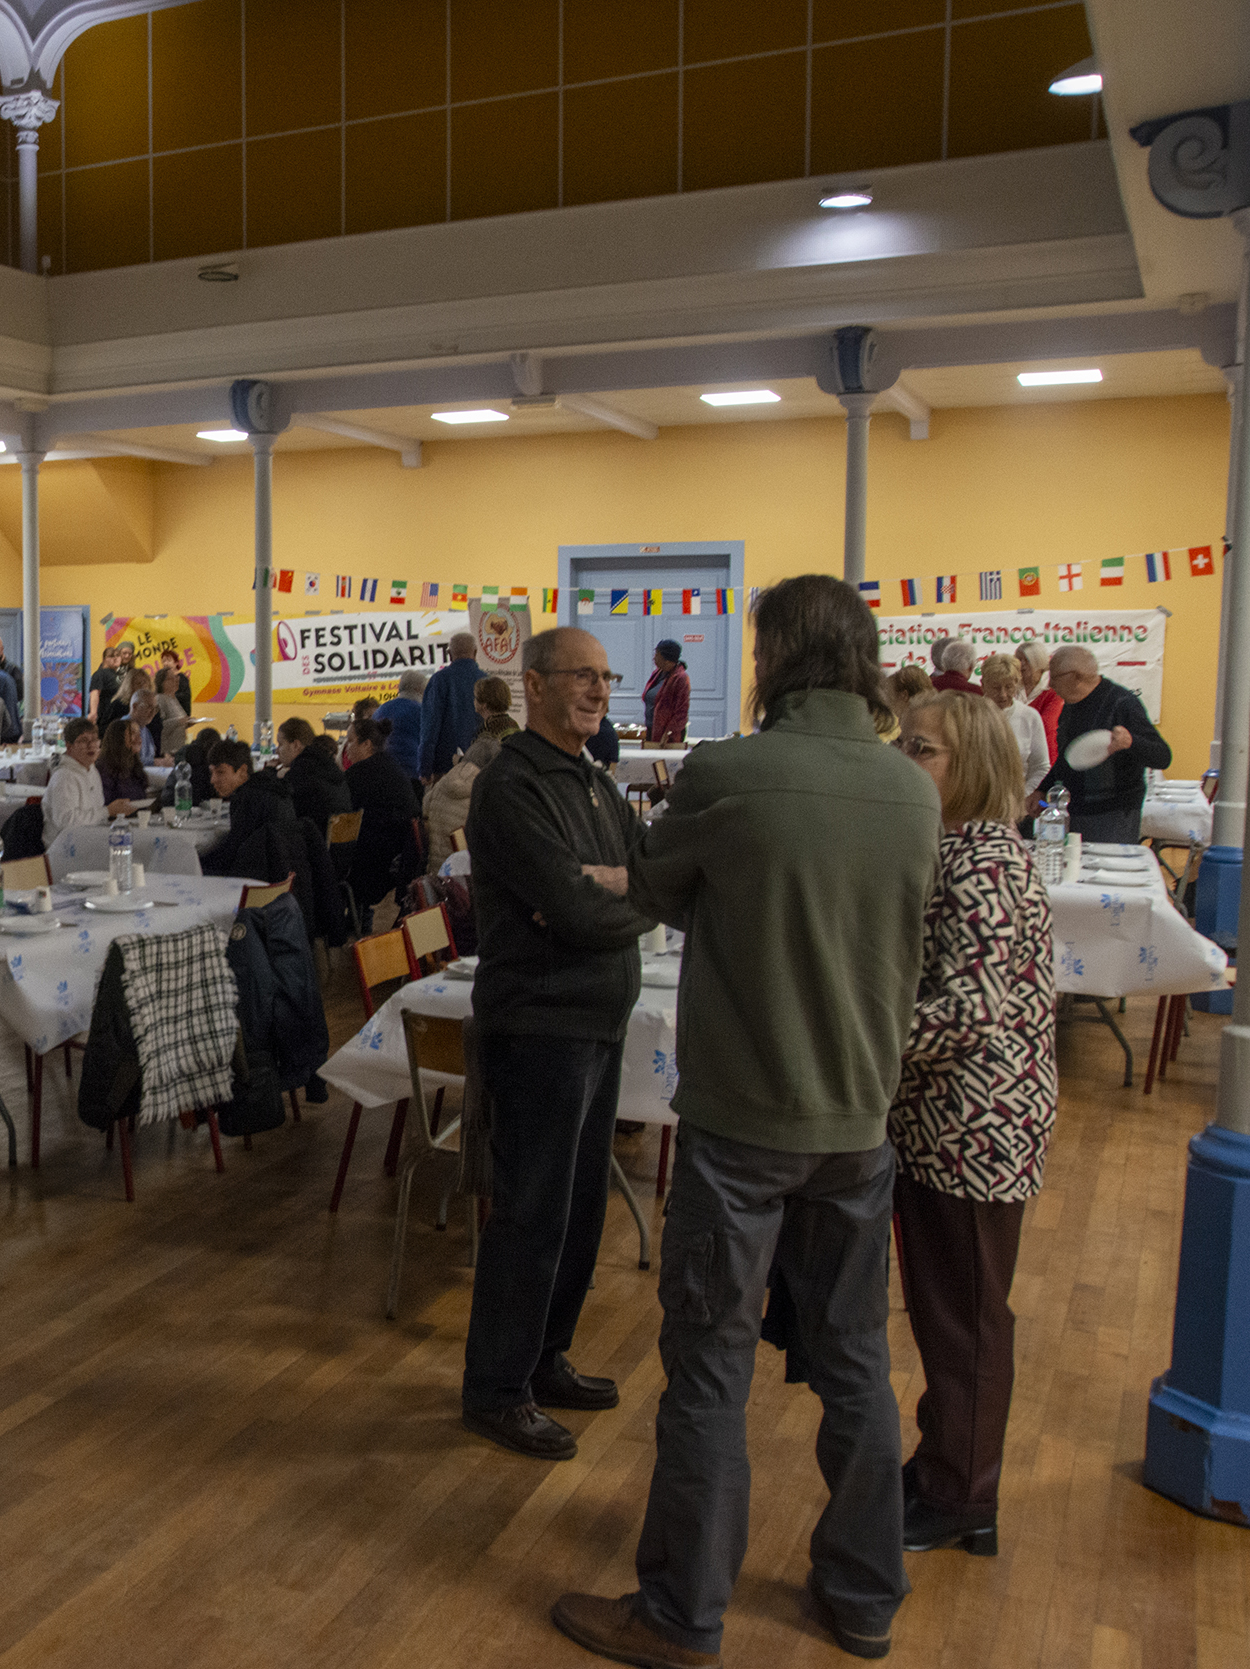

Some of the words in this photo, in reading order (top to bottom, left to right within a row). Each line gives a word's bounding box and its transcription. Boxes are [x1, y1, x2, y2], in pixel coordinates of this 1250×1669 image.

[137, 631, 152, 647] LE
[300, 619, 419, 649] FESTIVAL
[877, 623, 950, 646] ciation
[957, 620, 1148, 645] Franco-Italienne
[302, 655, 310, 675] DES
[313, 642, 449, 674] SOLIDARIT
[302, 687, 341, 698] Gymnase
[344, 684, 378, 693] Voltaire
